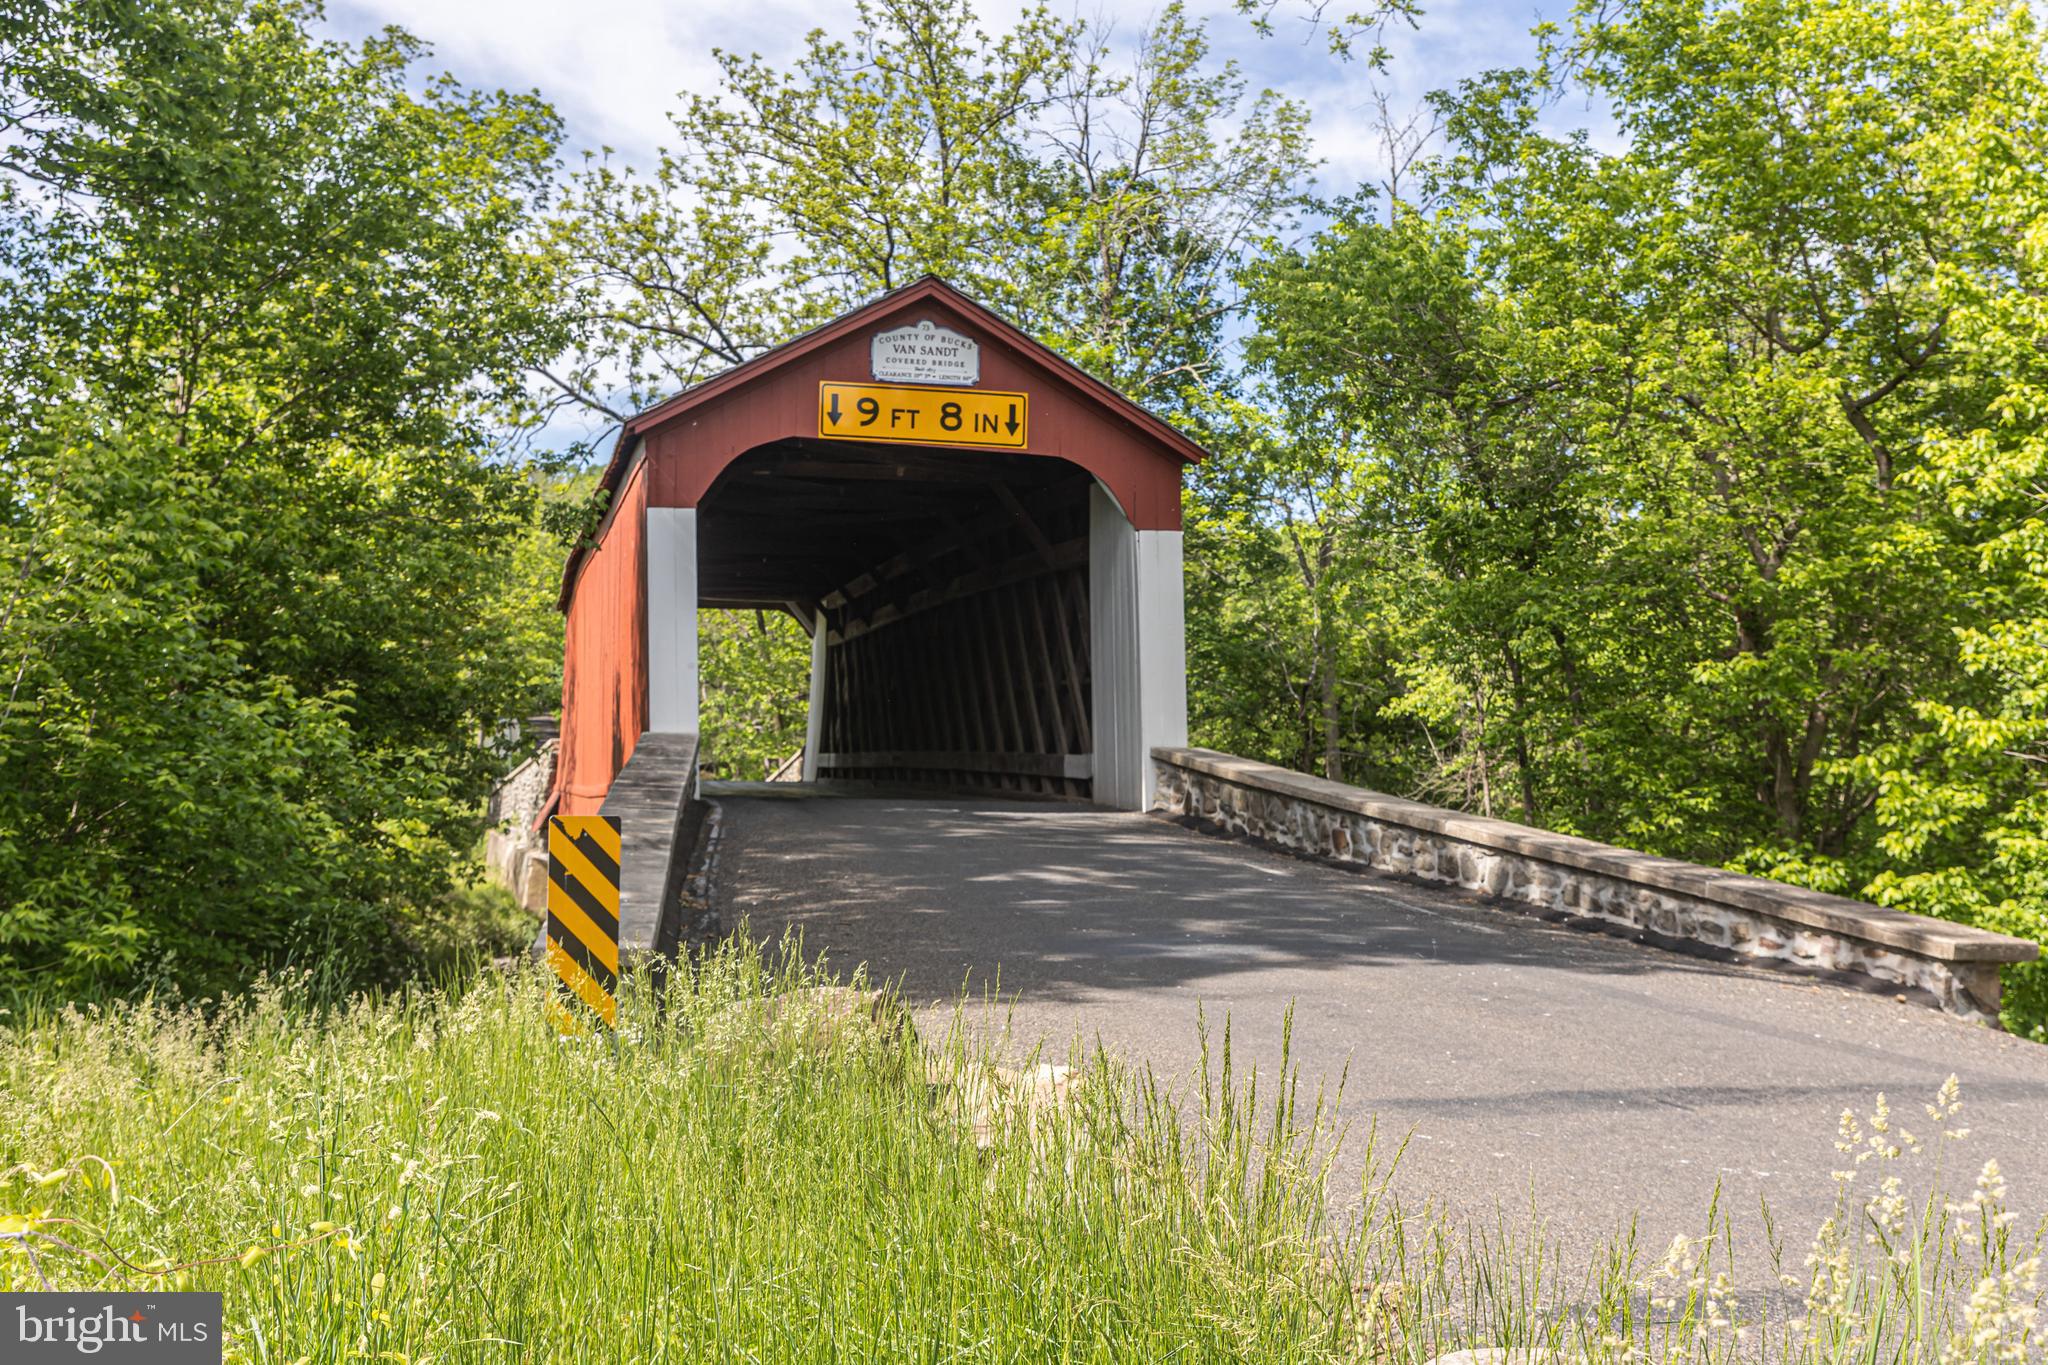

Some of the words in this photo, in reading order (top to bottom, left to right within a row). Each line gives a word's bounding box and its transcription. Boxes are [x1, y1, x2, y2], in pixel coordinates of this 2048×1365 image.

[878, 333, 920, 344] COUNTY
[940, 336, 972, 350] BUCKS
[893, 344, 916, 354] VAN
[920, 346, 959, 357] SANDT
[885, 357, 927, 365] COVERED
[932, 360, 965, 368] BRIDGE
[856, 397, 880, 427] 9
[891, 408, 920, 429] FT
[940, 402, 963, 431] 8
[974, 413, 999, 433] IN
